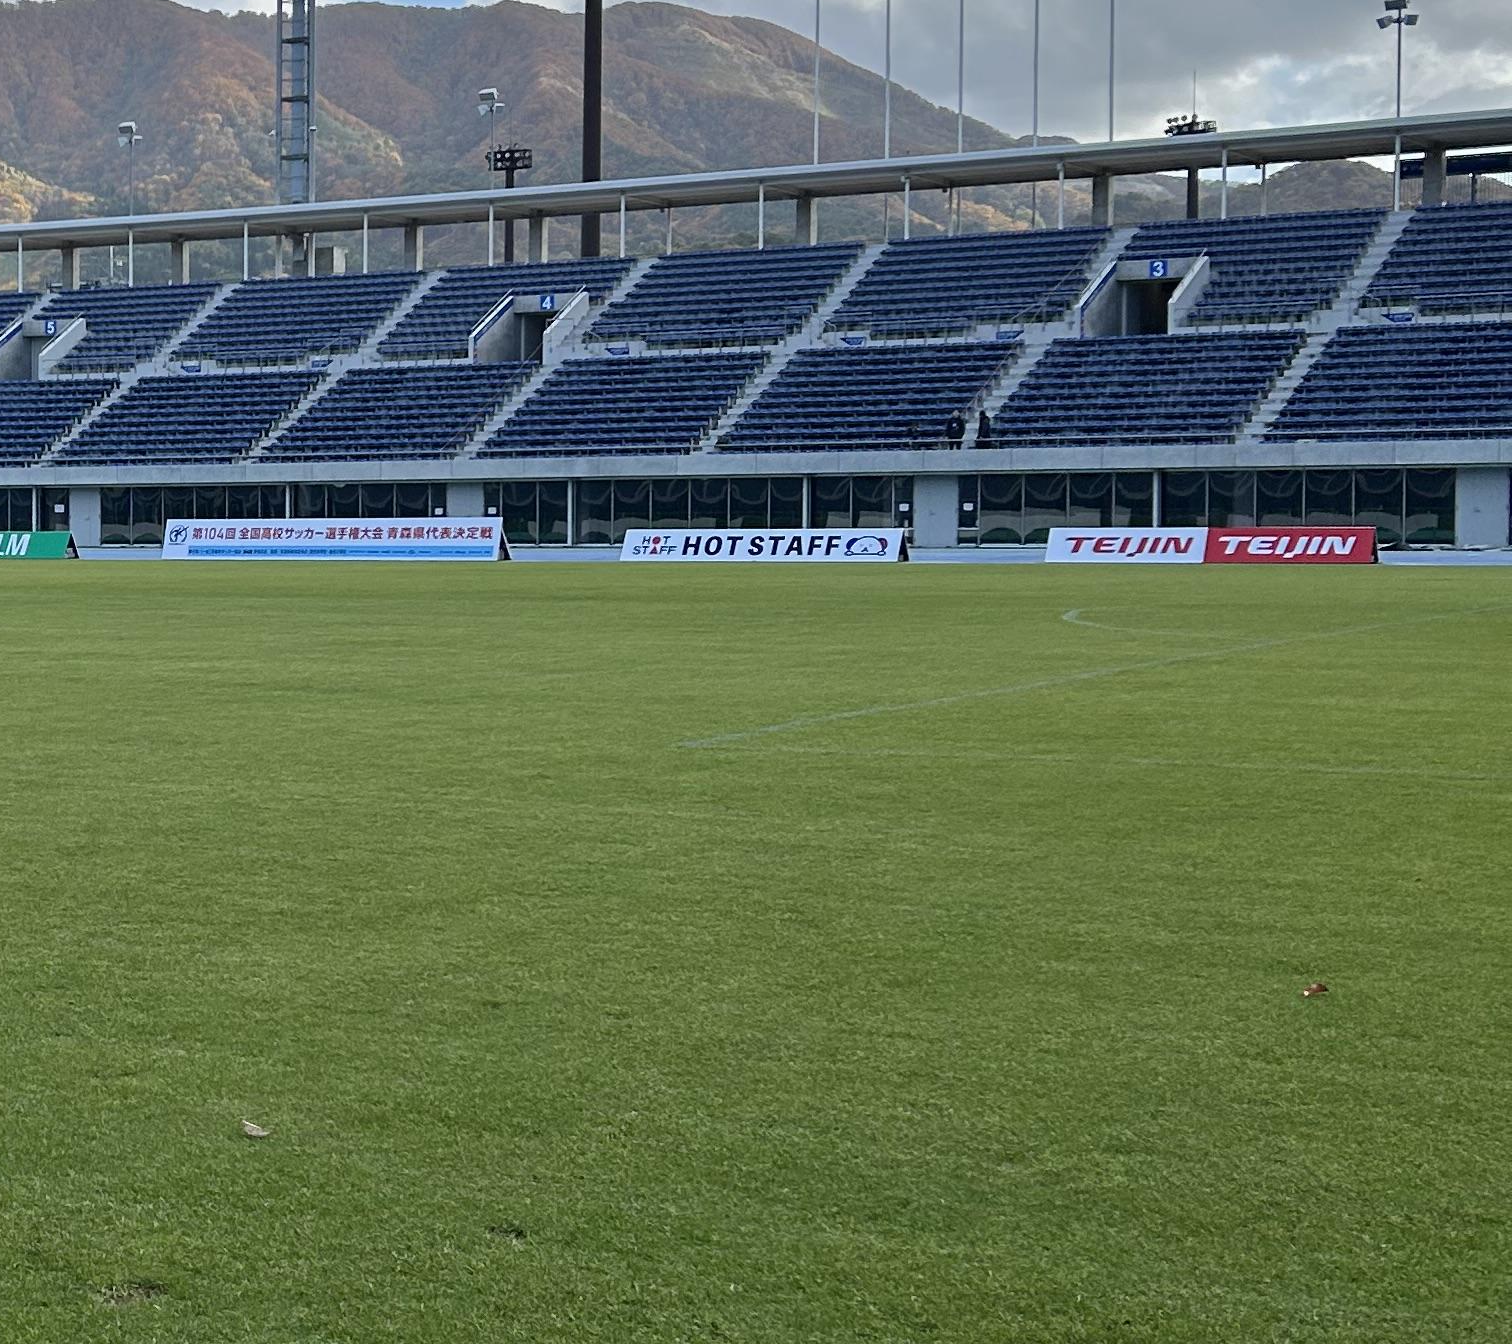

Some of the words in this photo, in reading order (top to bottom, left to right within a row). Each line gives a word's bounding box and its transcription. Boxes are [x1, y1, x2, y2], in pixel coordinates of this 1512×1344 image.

[1152, 261, 1165, 276] 3
[542, 296, 552, 309] 4
[192, 527, 236, 540] 第104回
[238, 526, 383, 540] 全国高校サッカー選手権大会
[388, 526, 494, 540] 青森県代表決定戦
[642, 536, 671, 545] HOT
[682, 535, 744, 556] HOT
[748, 535, 842, 556] STAFF
[1066, 536, 1195, 557] TEIJIN
[1218, 535, 1357, 559] TEIJIN
[632, 545, 678, 555] STAFF
